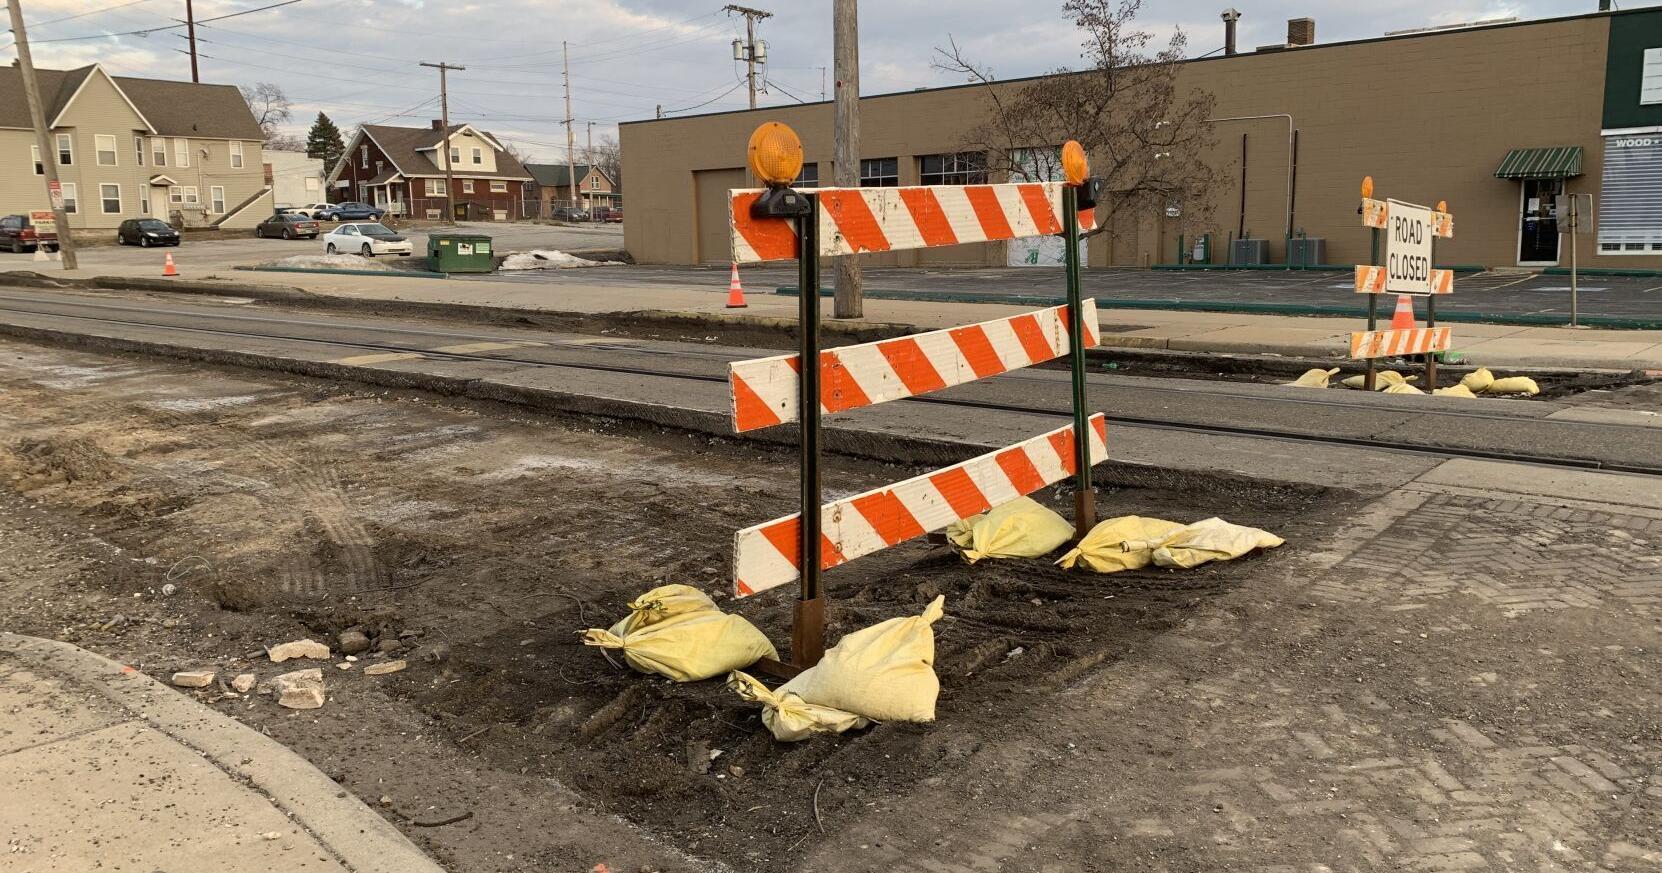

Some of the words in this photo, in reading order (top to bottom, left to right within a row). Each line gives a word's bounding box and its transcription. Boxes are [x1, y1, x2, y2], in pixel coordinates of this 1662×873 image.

[1615, 138, 1652, 148] WOOD
[1395, 215, 1423, 245] ROAD
[1389, 252, 1428, 282] CLOSED
